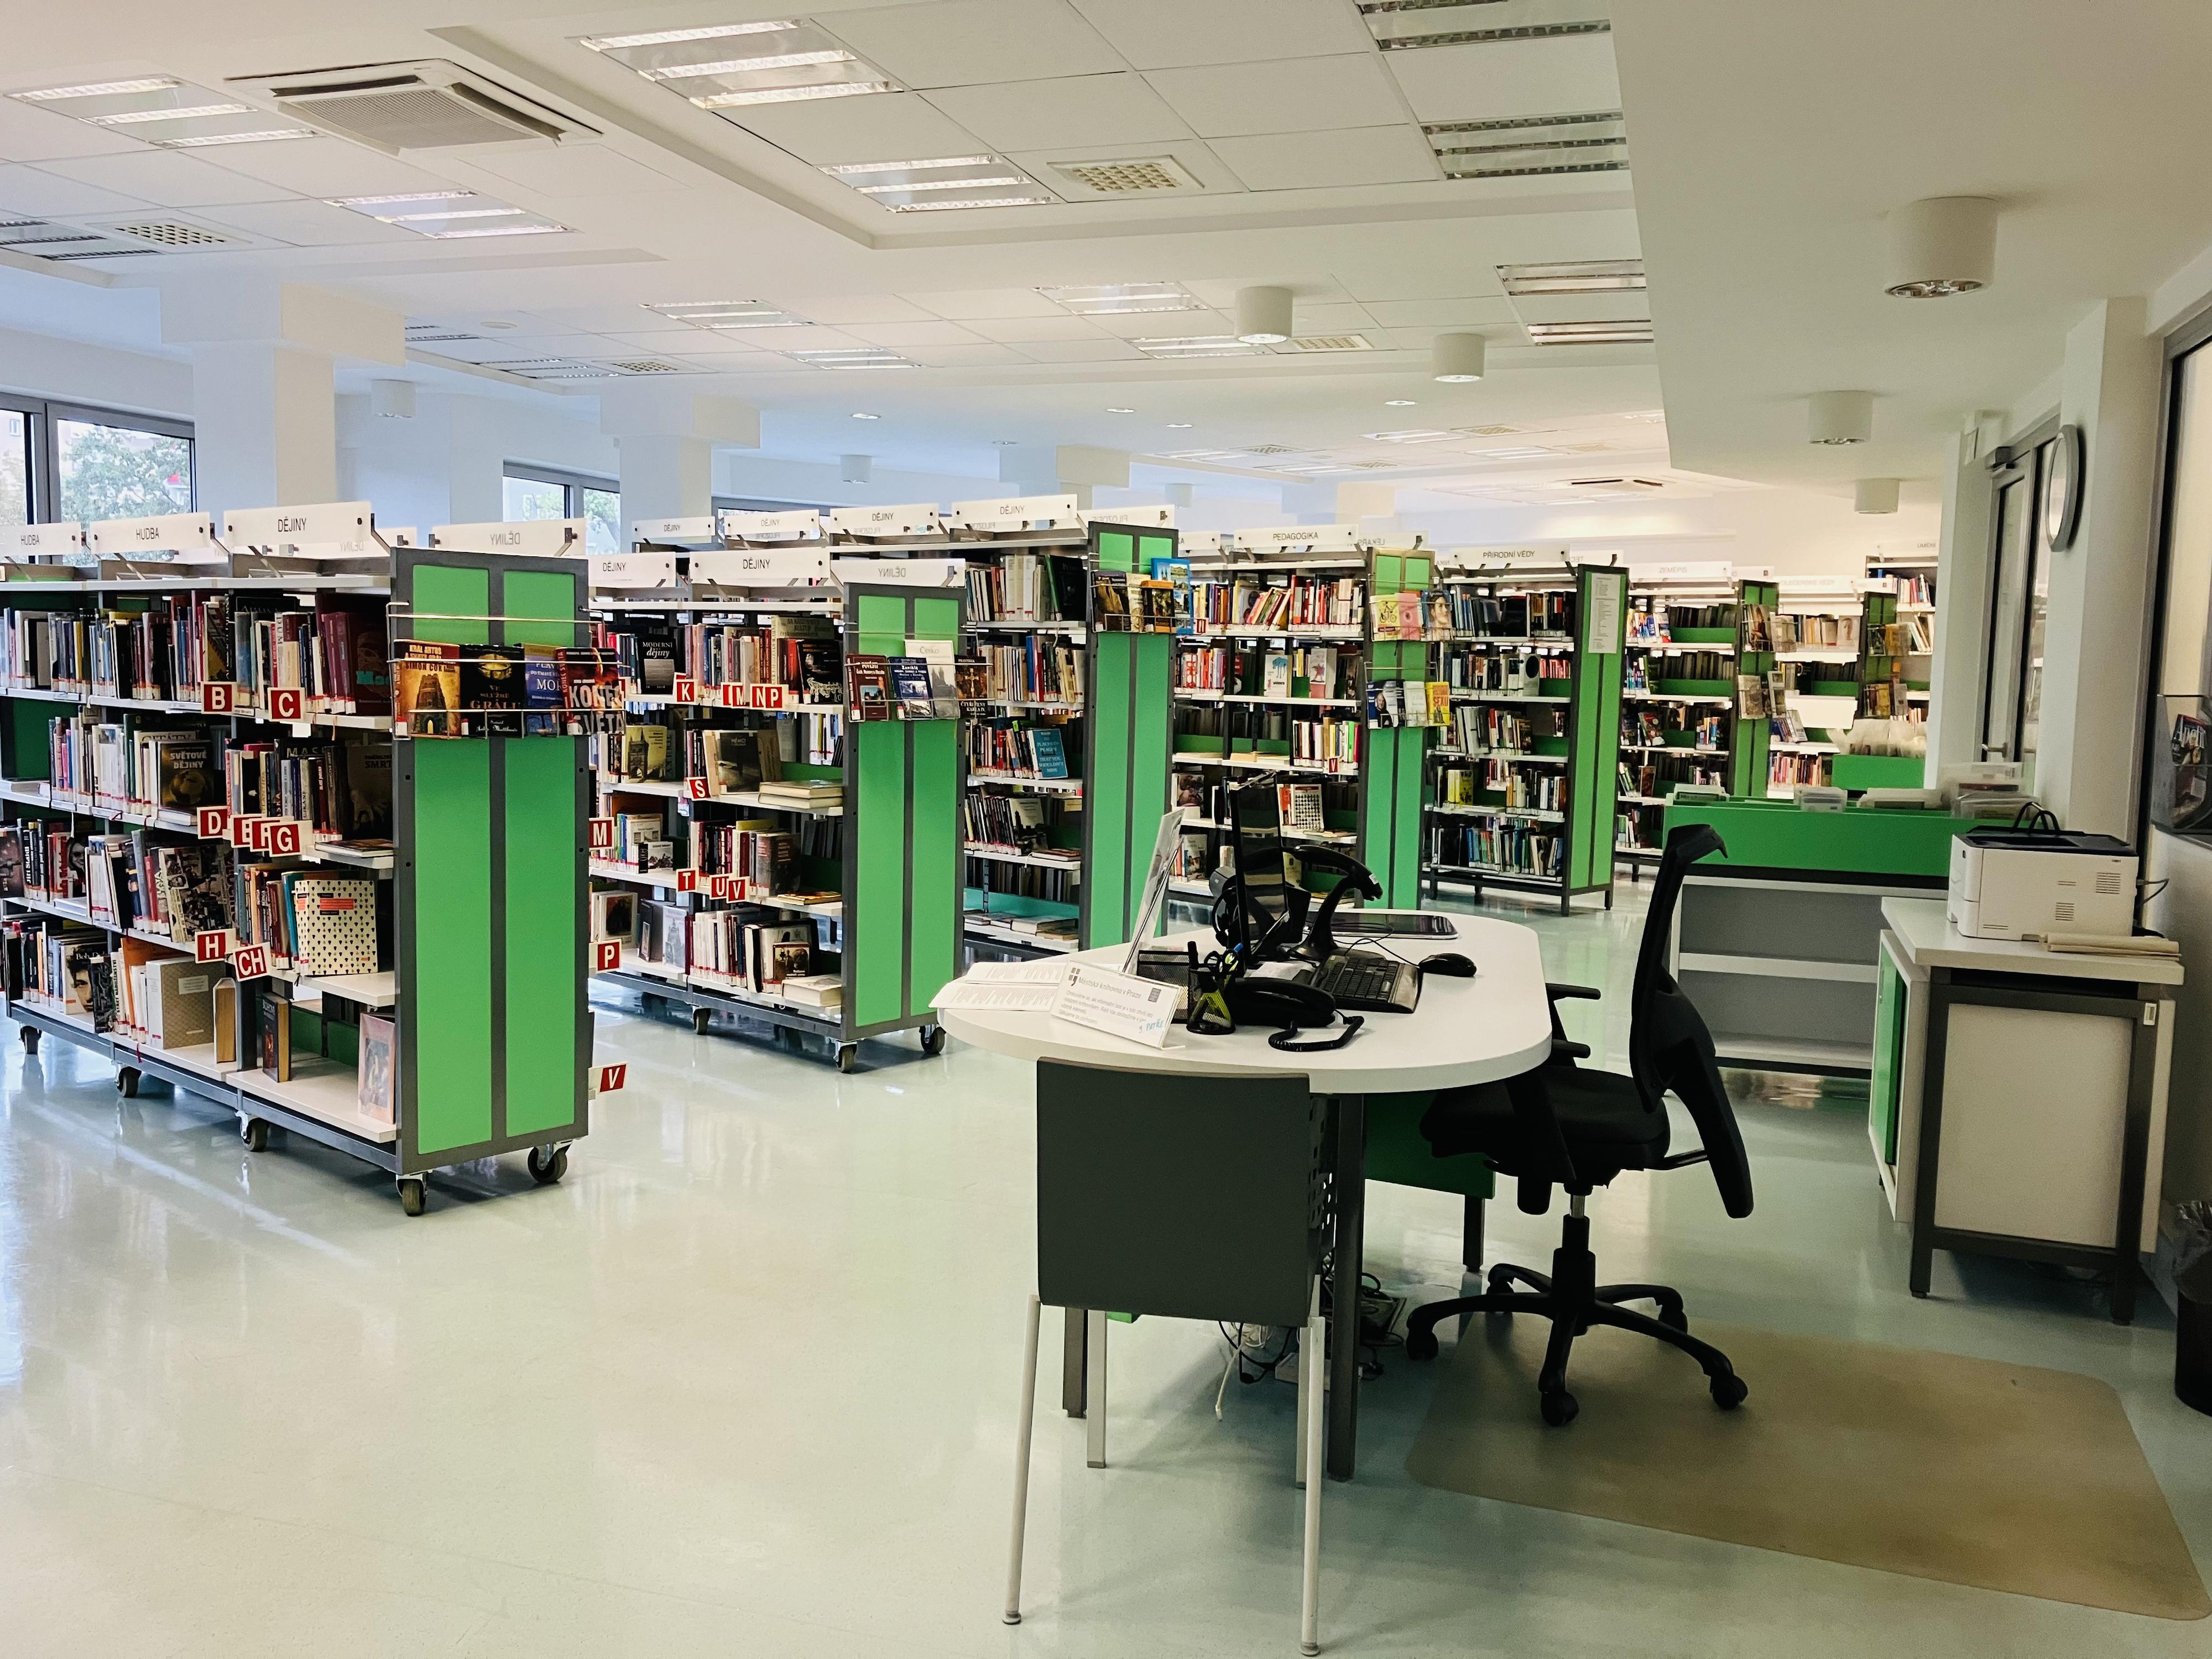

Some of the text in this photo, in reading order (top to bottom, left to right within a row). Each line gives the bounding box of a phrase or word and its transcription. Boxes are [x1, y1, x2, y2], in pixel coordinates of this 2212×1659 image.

[872, 513, 894, 521] DĚJINY
[1000, 504, 1025, 515] DĚJINY
[278, 516, 307, 533] DĚJINY
[664, 524, 681, 532] DĚJINY
[761, 518, 780, 527] DĚJINY
[20, 534, 40, 546] HUDBA
[136, 527, 160, 540] HUDBA
[1273, 531, 1318, 541] PEDAGOGIKA
[1483, 550, 1516, 559] PŘÍRODNÍ
[602, 560, 627, 572] DĚJINY
[743, 557, 770, 570] DĚJINY
[646, 646, 670, 659] dějiny
[212, 687, 225, 709] B
[682, 683, 691, 701] K
[757, 687, 764, 707] N
[770, 688, 778, 707] P
[278, 692, 294, 717] C
[170, 750, 207, 760] SVĚTOVÉ
[174, 760, 204, 769] DĚJINY
[1331, 758, 1336, 772] V
[695, 780, 705, 797] S
[208, 811, 221, 834] D
[277, 827, 293, 852] G
[593, 823, 607, 846] M
[682, 872, 691, 889] T
[716, 877, 725, 896] U
[733, 881, 741, 899] V
[205, 935, 219, 958] H
[238, 949, 265, 976] CH
[604, 945, 614, 968] P
[608, 1067, 620, 1088] V
